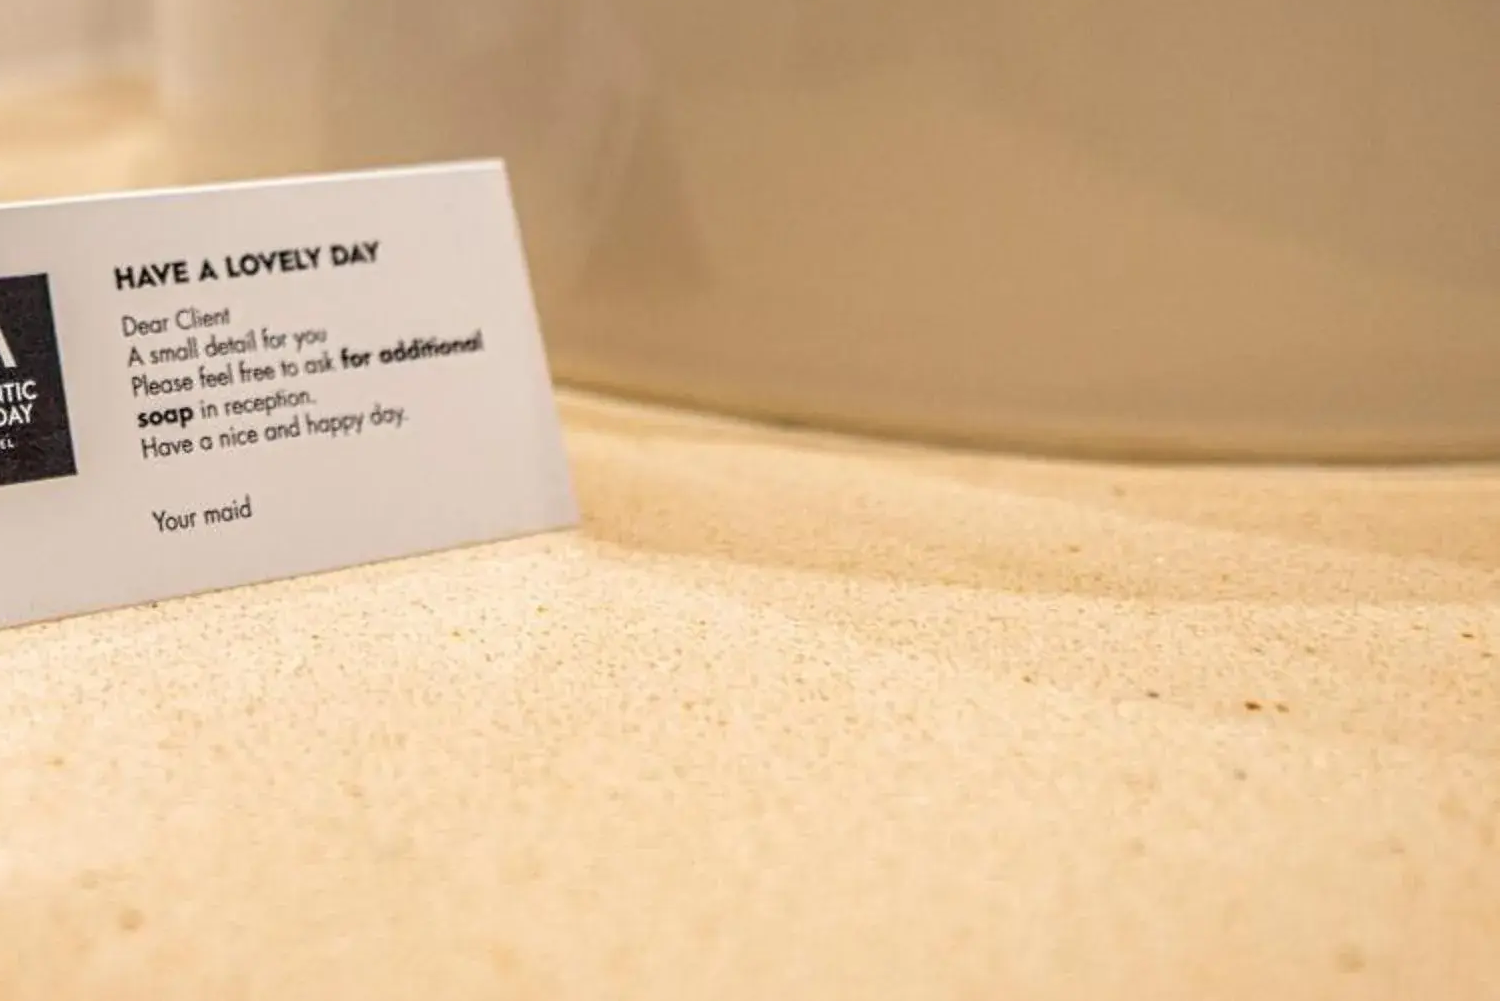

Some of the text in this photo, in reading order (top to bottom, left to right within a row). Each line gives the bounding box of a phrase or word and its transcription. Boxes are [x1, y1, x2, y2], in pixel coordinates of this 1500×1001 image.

[113, 241, 381, 291] HAVE A LOVELY DAY
[121, 306, 231, 338] Dear Client
[127, 327, 328, 368] A small detail for you
[132, 330, 485, 399] Please feel free to ask for additional
[136, 388, 317, 432] soap in reception.
[141, 401, 410, 460] Have a nice and happy day.
[151, 494, 252, 532] Your maid
